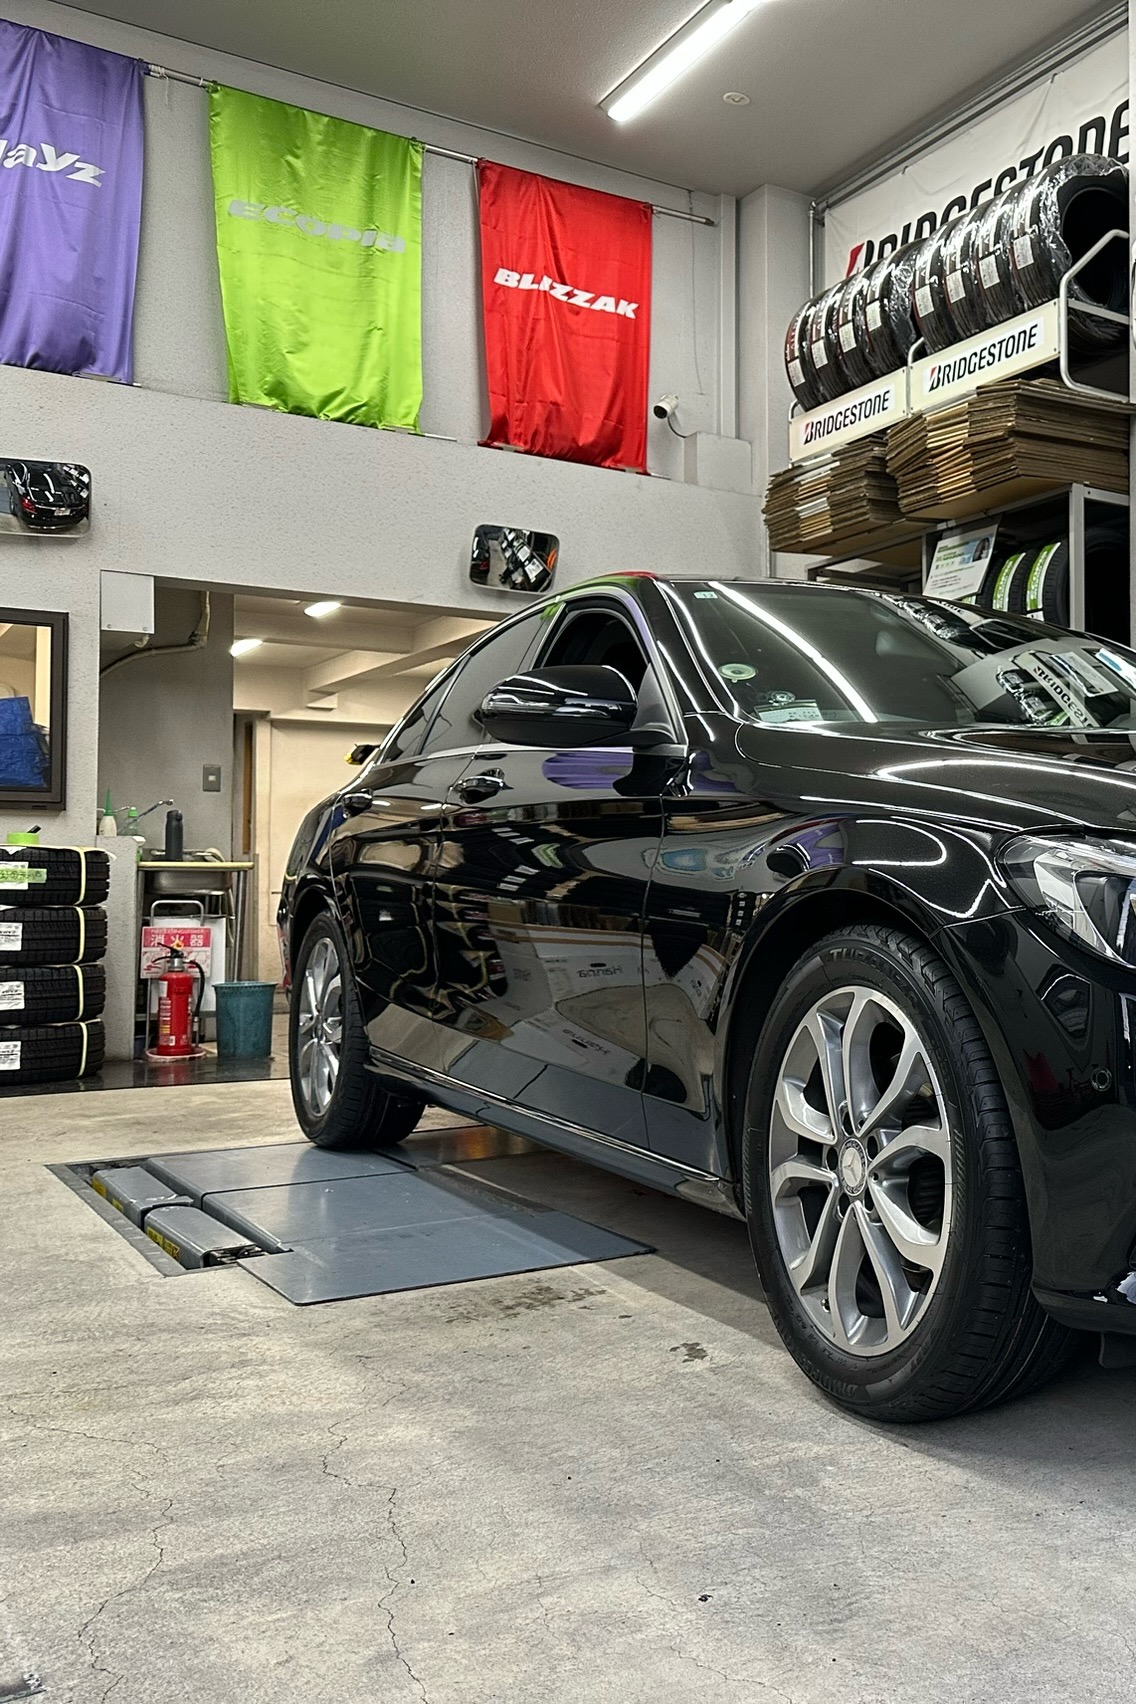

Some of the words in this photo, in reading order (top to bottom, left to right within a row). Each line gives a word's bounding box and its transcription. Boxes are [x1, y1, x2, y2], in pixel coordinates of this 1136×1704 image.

[493, 267, 637, 320] BLIZZAK
[929, 321, 1039, 393] BRIDGESTONE
[803, 389, 891, 446] BRIDGESTONE
[150, 934, 204, 948] 消火器
